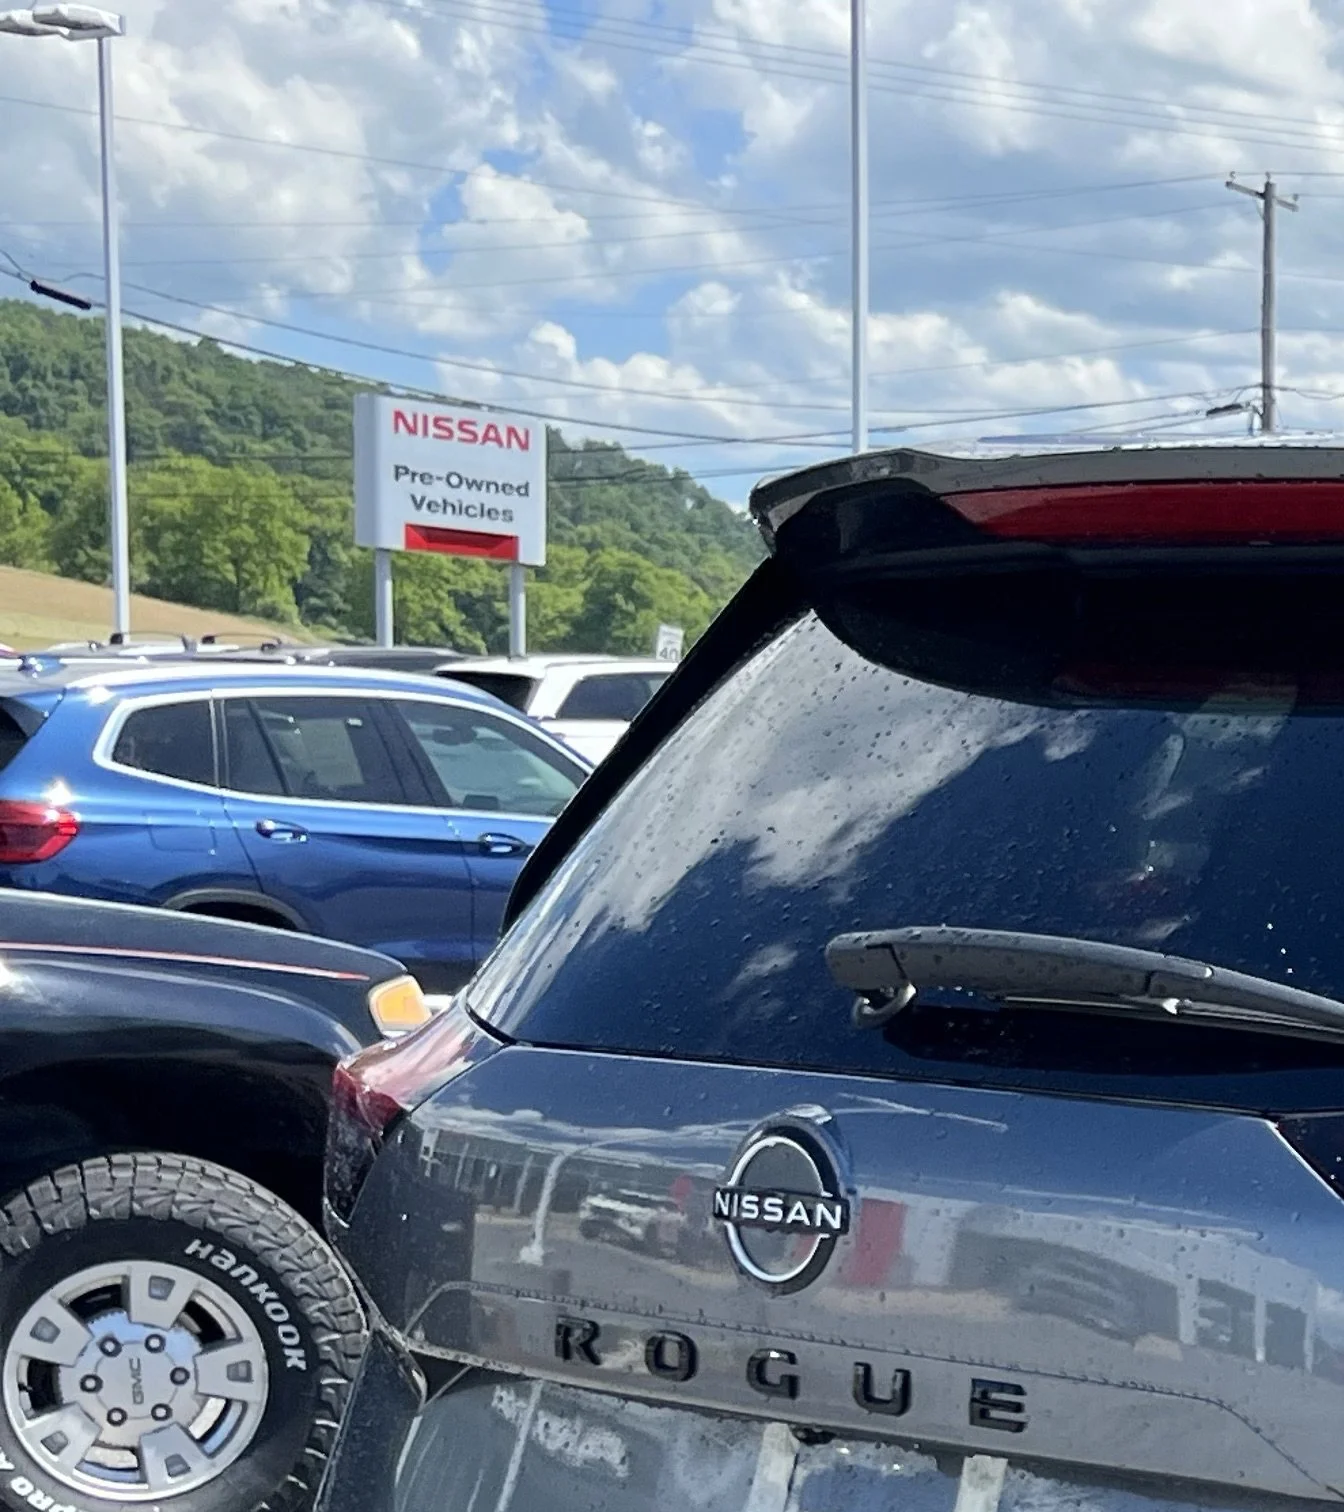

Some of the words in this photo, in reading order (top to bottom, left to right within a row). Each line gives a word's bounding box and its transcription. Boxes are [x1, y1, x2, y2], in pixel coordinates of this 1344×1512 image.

[393, 408, 530, 452] NISSAN
[393, 464, 530, 498] Pre-Owned
[410, 494, 515, 523] Vehicles
[714, 1190, 843, 1231] NISSAN
[129, 1357, 145, 1405] GMC
[554, 1316, 1029, 1434] ROGUE
